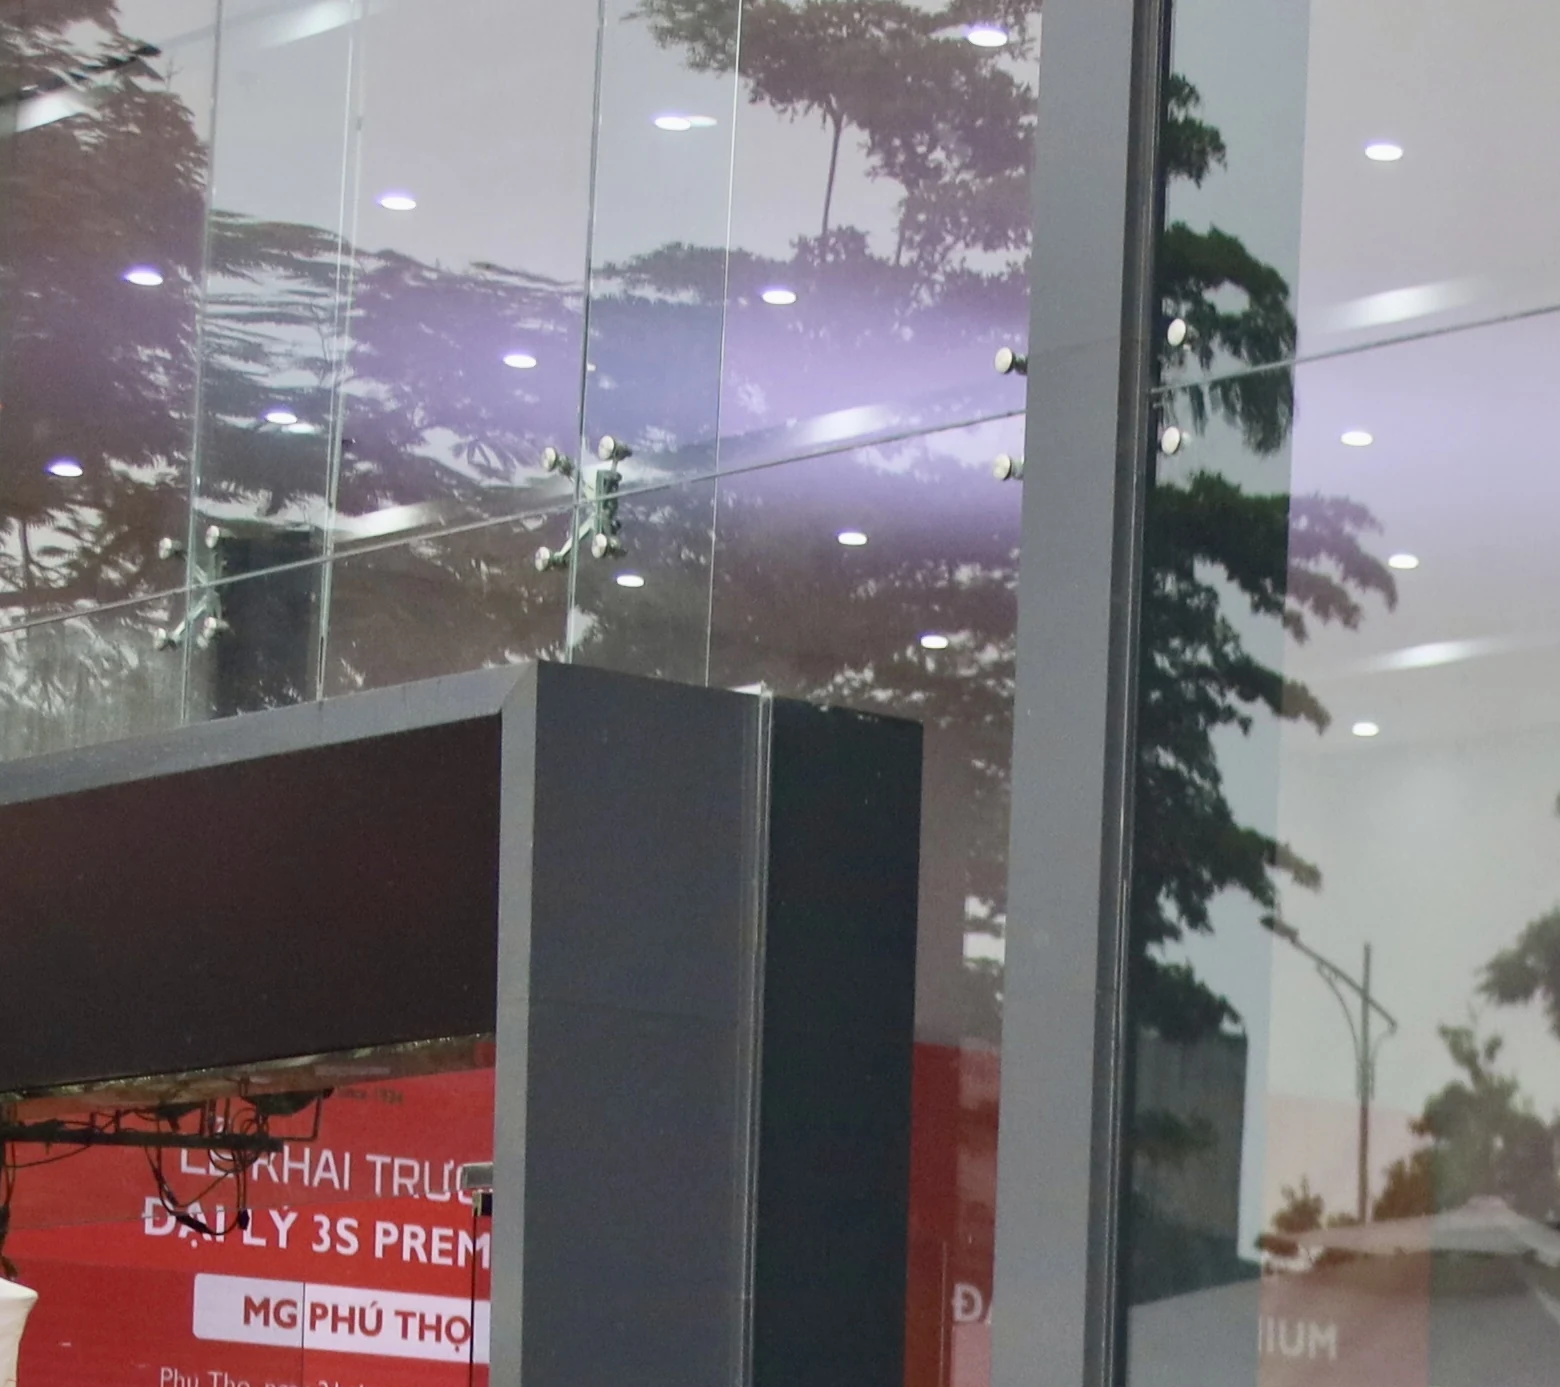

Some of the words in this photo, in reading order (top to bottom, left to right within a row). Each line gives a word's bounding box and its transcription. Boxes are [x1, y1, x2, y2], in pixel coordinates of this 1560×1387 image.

[251, 1142, 351, 1191] KHAI
[142, 1195, 226, 1250] ĐẠI
[310, 1213, 360, 1257] 3S
[373, 1219, 491, 1270] PREM
[242, 1295, 299, 1331] MG
[308, 1299, 384, 1338] PHÚ
[394, 1309, 472, 1353] THỌ
[951, 1280, 993, 1325] Đ
[1258, 1315, 1338, 1361] IUM
